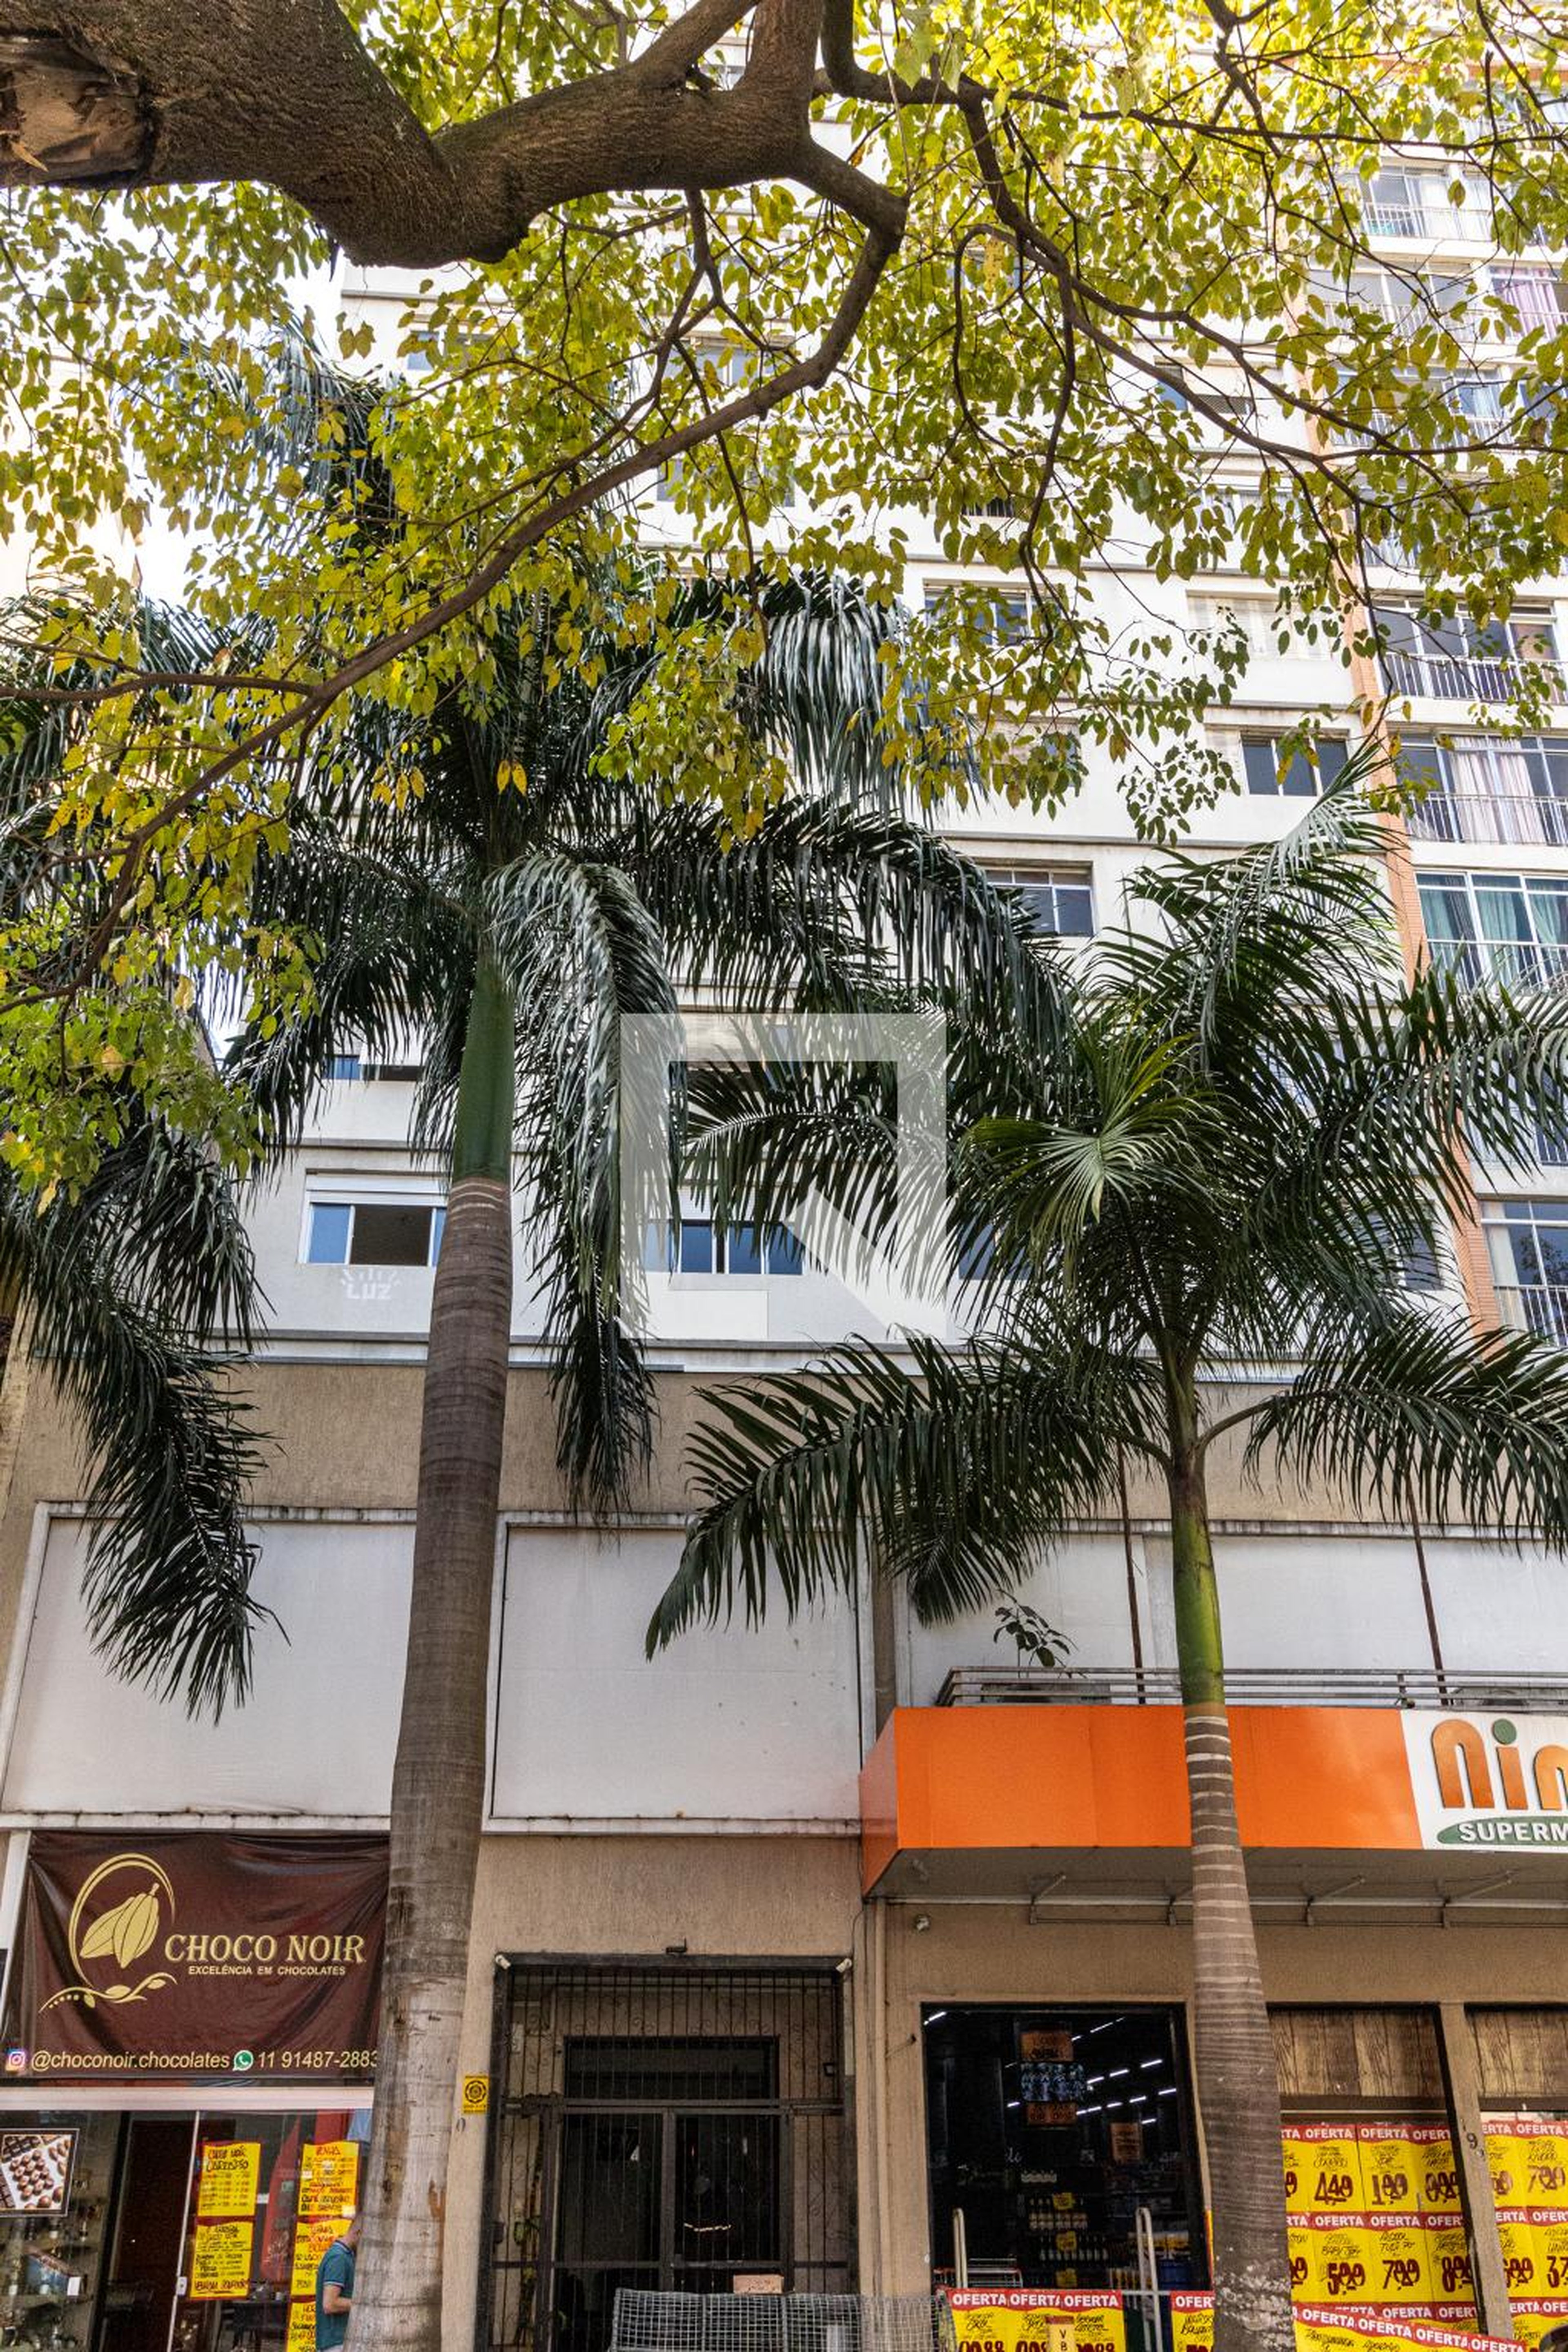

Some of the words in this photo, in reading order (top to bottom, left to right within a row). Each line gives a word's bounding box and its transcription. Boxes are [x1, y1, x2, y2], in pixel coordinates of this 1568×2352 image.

[165, 1934, 277, 1961] CHOCO
[287, 1935, 366, 1963] NOIR
[257, 1966, 272, 1975] EM
[277, 1966, 345, 1975] CHOCOLATES
[31, 2050, 230, 2071] @choconoir.chocolates
[258, 2051, 275, 2067] 11
[1305, 2128, 1353, 2138] OFERTA
[1361, 2128, 1409, 2139] OFERTA
[1517, 2124, 1564, 2135] OFERTA
[1315, 2216, 1364, 2226] OFERTA
[1371, 2216, 1421, 2227] OFERTA
[1428, 2216, 1463, 2226] OFER
[1496, 2212, 1526, 2222] ERTA
[1532, 2211, 1568, 2222] OFER
[953, 2294, 1007, 2305] OFERTA
[1064, 2294, 1119, 2307] OFERTA
[1175, 2296, 1215, 2308] OFER
[1383, 2307, 1432, 2318] OFERTA
[1511, 2302, 1539, 2313] ERTA
[1302, 2309, 1355, 2328] OFERTA
[1359, 2319, 1412, 2338] OFERTA
[1416, 2328, 1468, 2348] OFERTA
